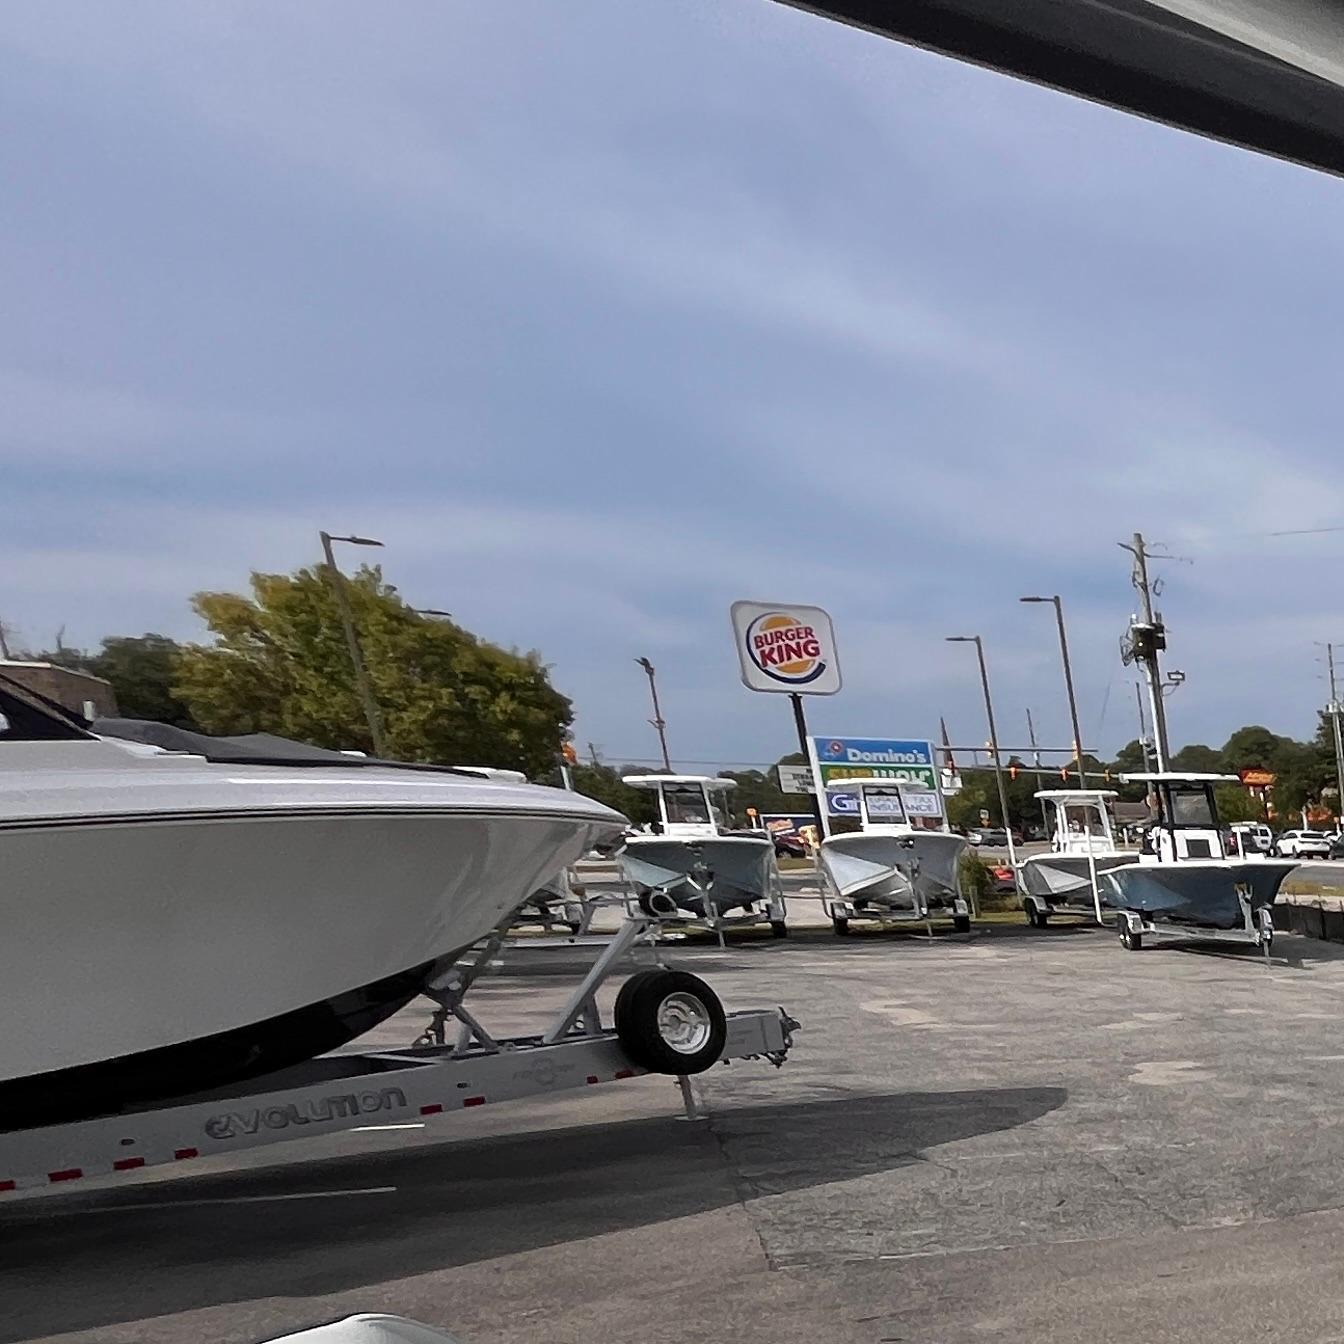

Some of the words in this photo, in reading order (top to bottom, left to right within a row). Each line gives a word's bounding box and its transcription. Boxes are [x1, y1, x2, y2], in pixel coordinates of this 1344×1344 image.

[753, 626, 815, 650] BURGER
[760, 639, 820, 668] KING
[846, 748, 927, 763] Domino's
